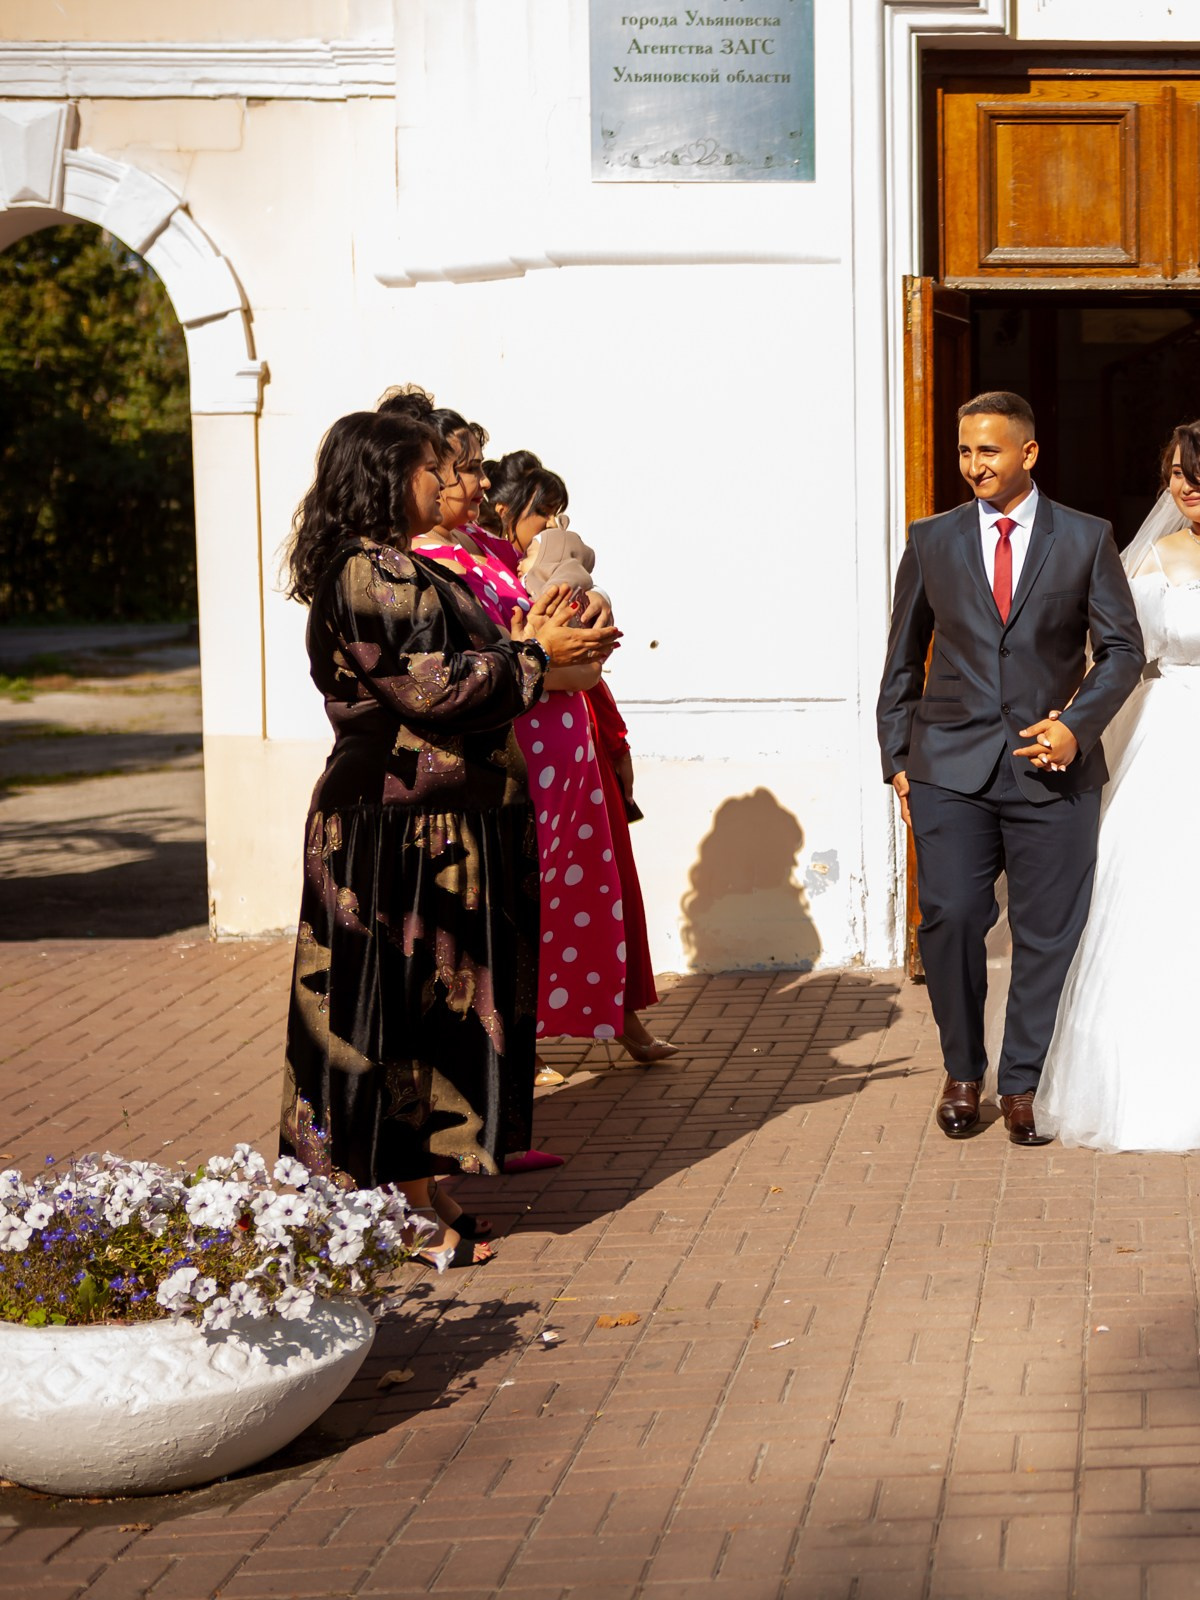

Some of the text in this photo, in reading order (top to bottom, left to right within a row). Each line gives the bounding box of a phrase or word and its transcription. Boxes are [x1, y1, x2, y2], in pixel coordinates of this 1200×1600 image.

[621, 10, 781, 31] города Ульяновска
[627, 38, 775, 55] Агентства ЗАГС
[612, 66, 791, 83] Ульяновской области
